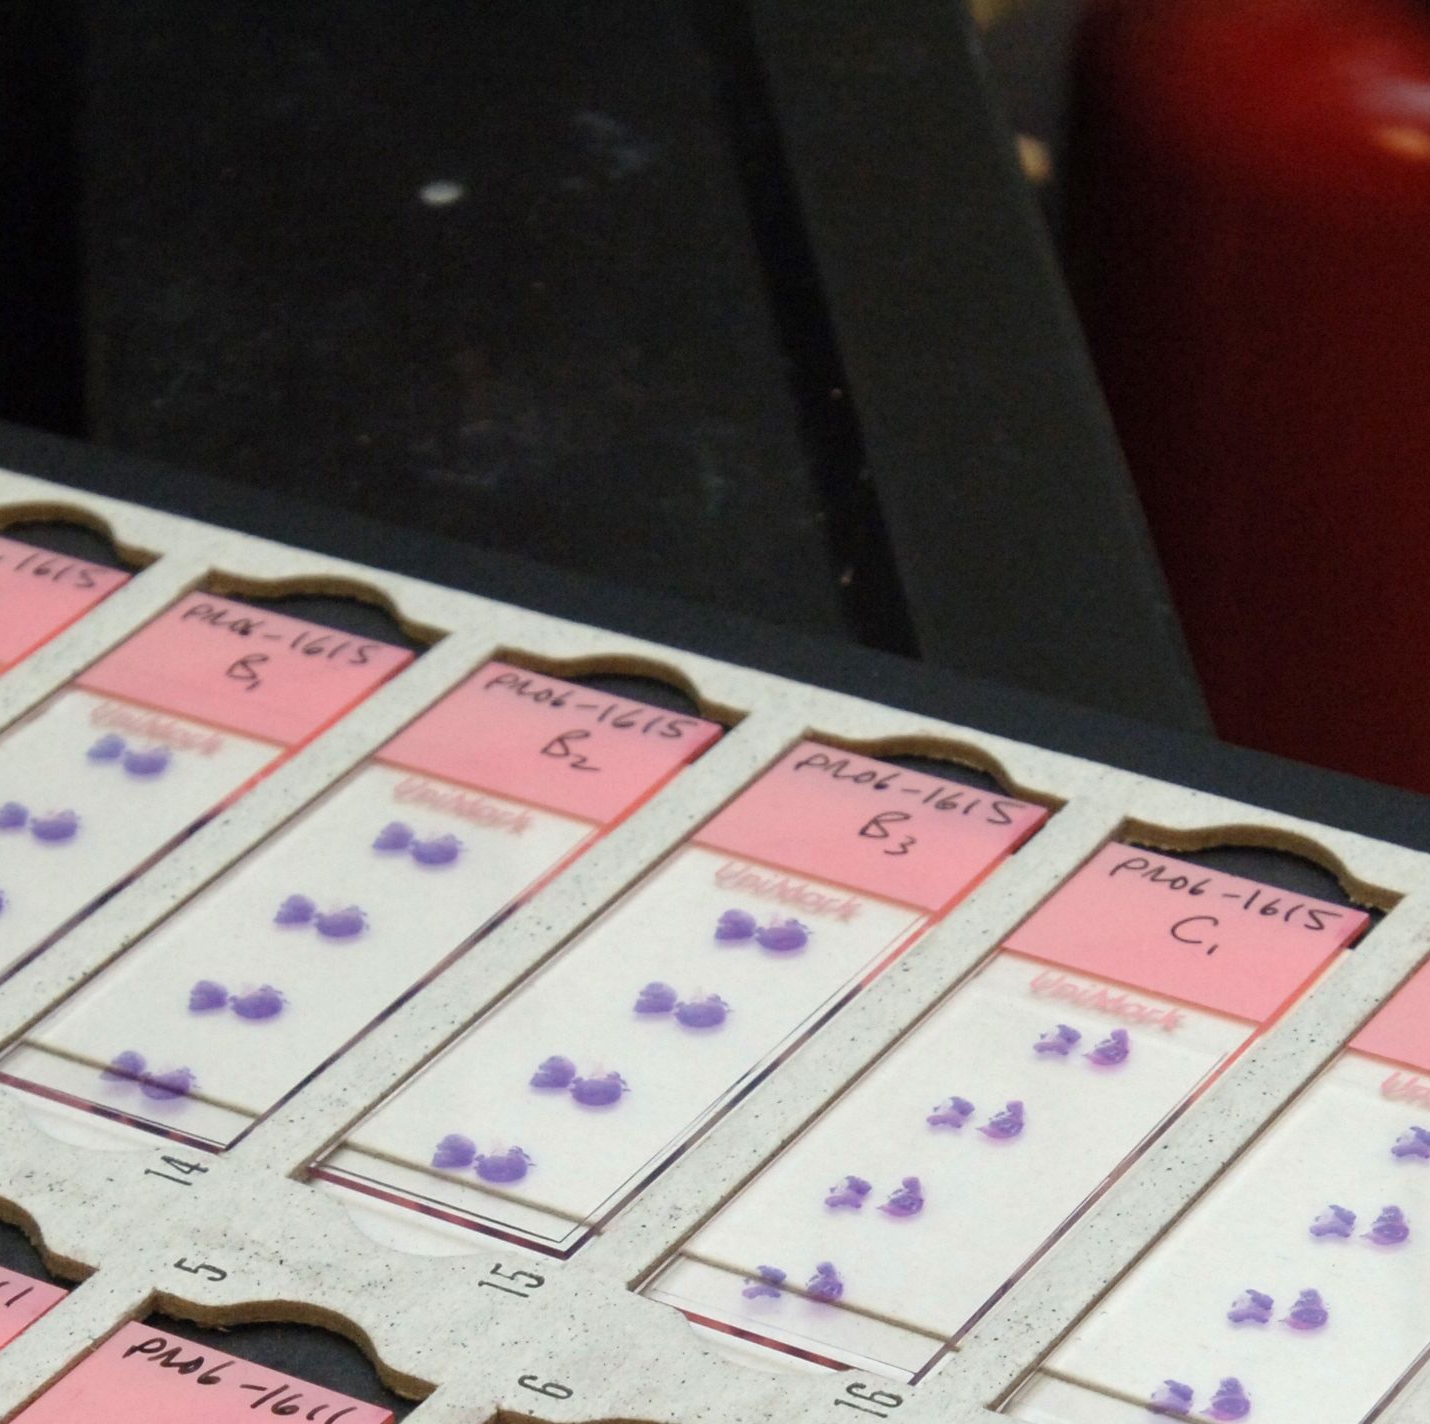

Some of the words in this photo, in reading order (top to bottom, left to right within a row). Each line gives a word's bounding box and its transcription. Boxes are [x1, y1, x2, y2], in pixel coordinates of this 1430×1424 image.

[1029, 968, 1188, 1035] UniMark
[143, 1153, 210, 1186] 14
[173, 1257, 228, 1283] 5
[477, 1262, 546, 1298] 15
[517, 1374, 574, 1401] 6
[833, 1381, 904, 1419] 16
